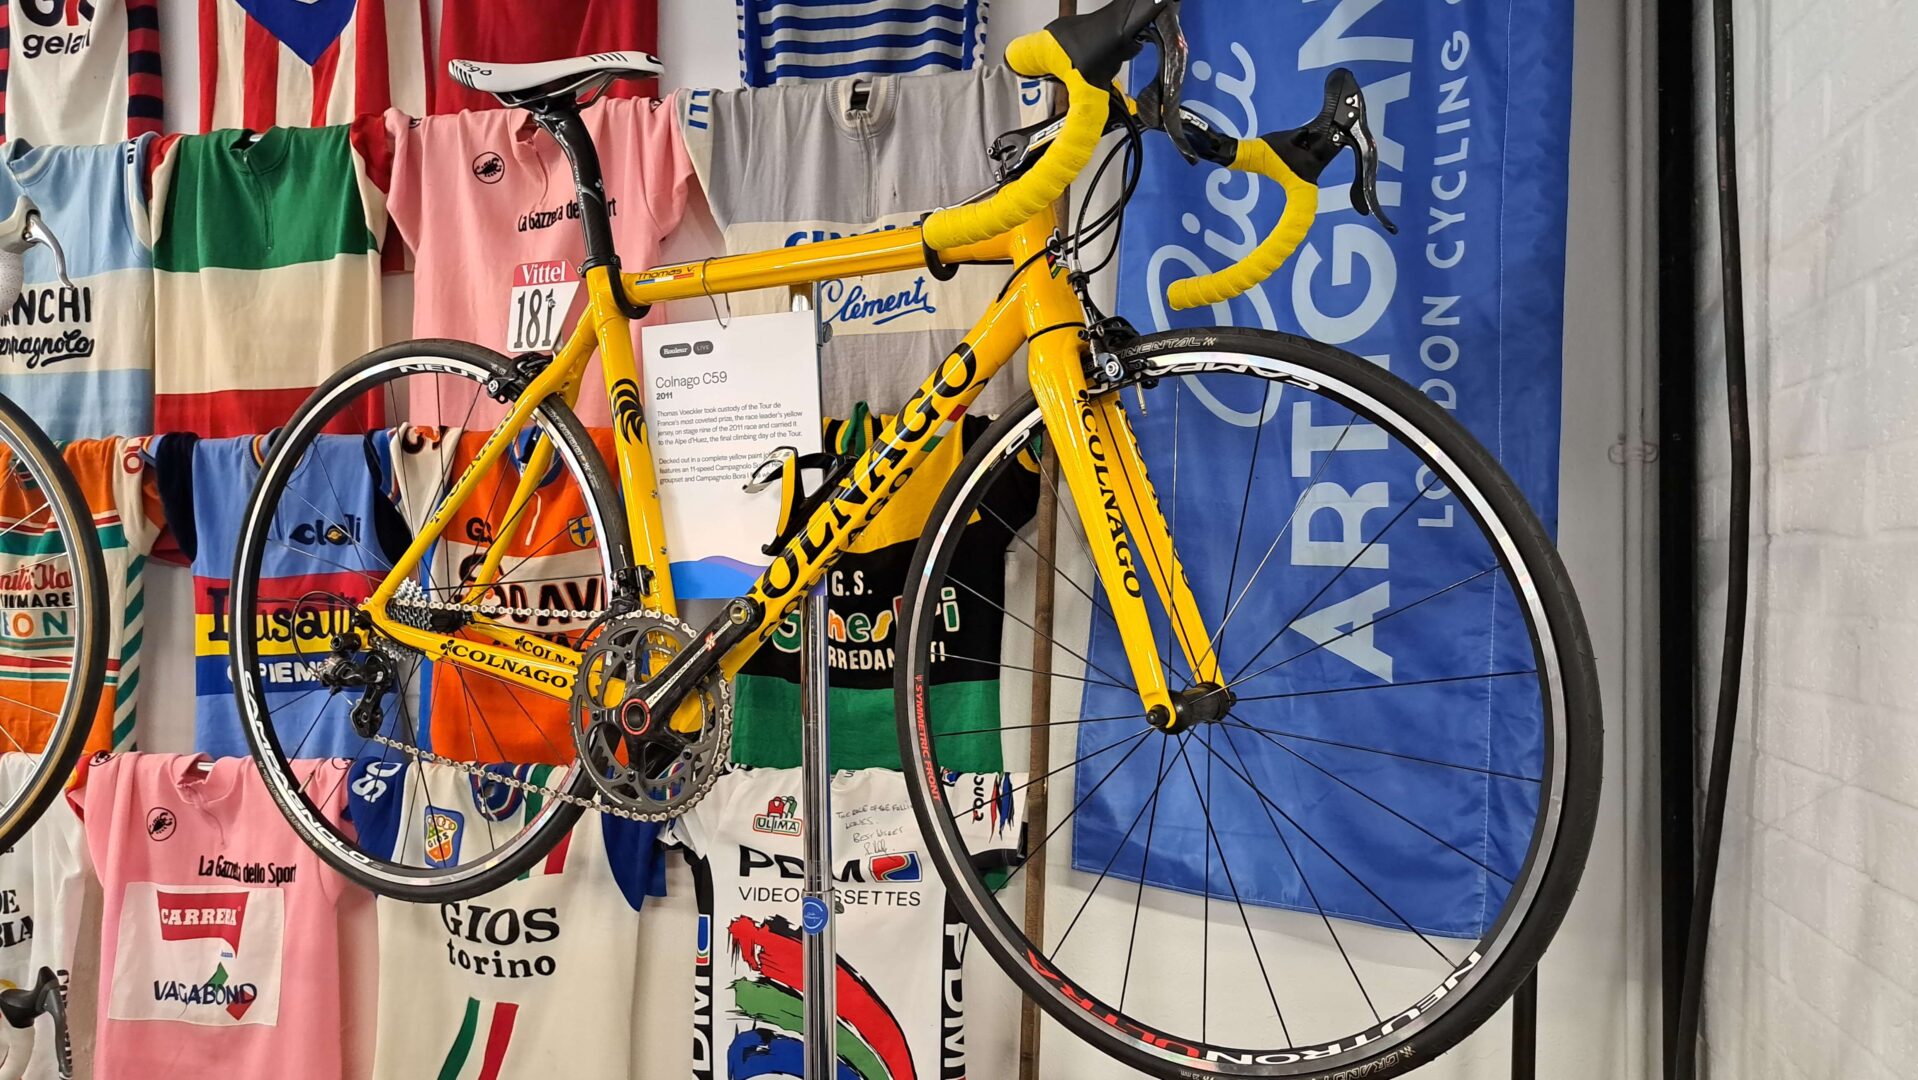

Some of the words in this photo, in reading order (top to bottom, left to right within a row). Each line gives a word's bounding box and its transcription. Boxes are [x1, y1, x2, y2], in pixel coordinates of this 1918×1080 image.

[1426, 30, 1471, 269] CYCLING
[522, 260, 566, 285] Vittel
[639, 268, 683, 280] Thomas
[514, 288, 554, 348] 181
[656, 375, 701, 389] Colnago
[702, 370, 728, 385] C59
[656, 391, 673, 400] 2011
[680, 408, 703, 416] Voeckler
[718, 404, 740, 413] custody
[695, 416, 717, 424] coveted
[759, 411, 782, 419] leader's
[784, 410, 802, 419] yellow
[1416, 295, 1461, 528] LODON
[733, 434, 757, 442] climbing
[758, 432, 768, 440] day
[771, 420, 792, 428] carried
[702, 454, 728, 462] complete
[729, 453, 746, 461] yellow
[748, 452, 762, 460] paint
[715, 463, 751, 471] Campagnolo
[696, 474, 732, 482] Campagnolo
[1081, 407, 1142, 599] COLNAGO
[832, 570, 873, 596] G.S.
[452, 645, 568, 689] COLNAGO
[915, 684, 931, 757] SYMMETRIC
[923, 758, 942, 802] FRONT
[244, 670, 371, 865] CAMPAGNOLO
[757, 815, 798, 833] ULTIMA
[198, 855, 215, 877] La
[243, 863, 266, 884] dello
[441, 901, 560, 946] GIOS
[446, 938, 556, 978] torino
[153, 979, 258, 1006] VAGABOND
[1027, 948, 1201, 1059] ULTRA
[1204, 950, 1483, 1066] NEUTRON
[692, 975, 711, 1080] DM
